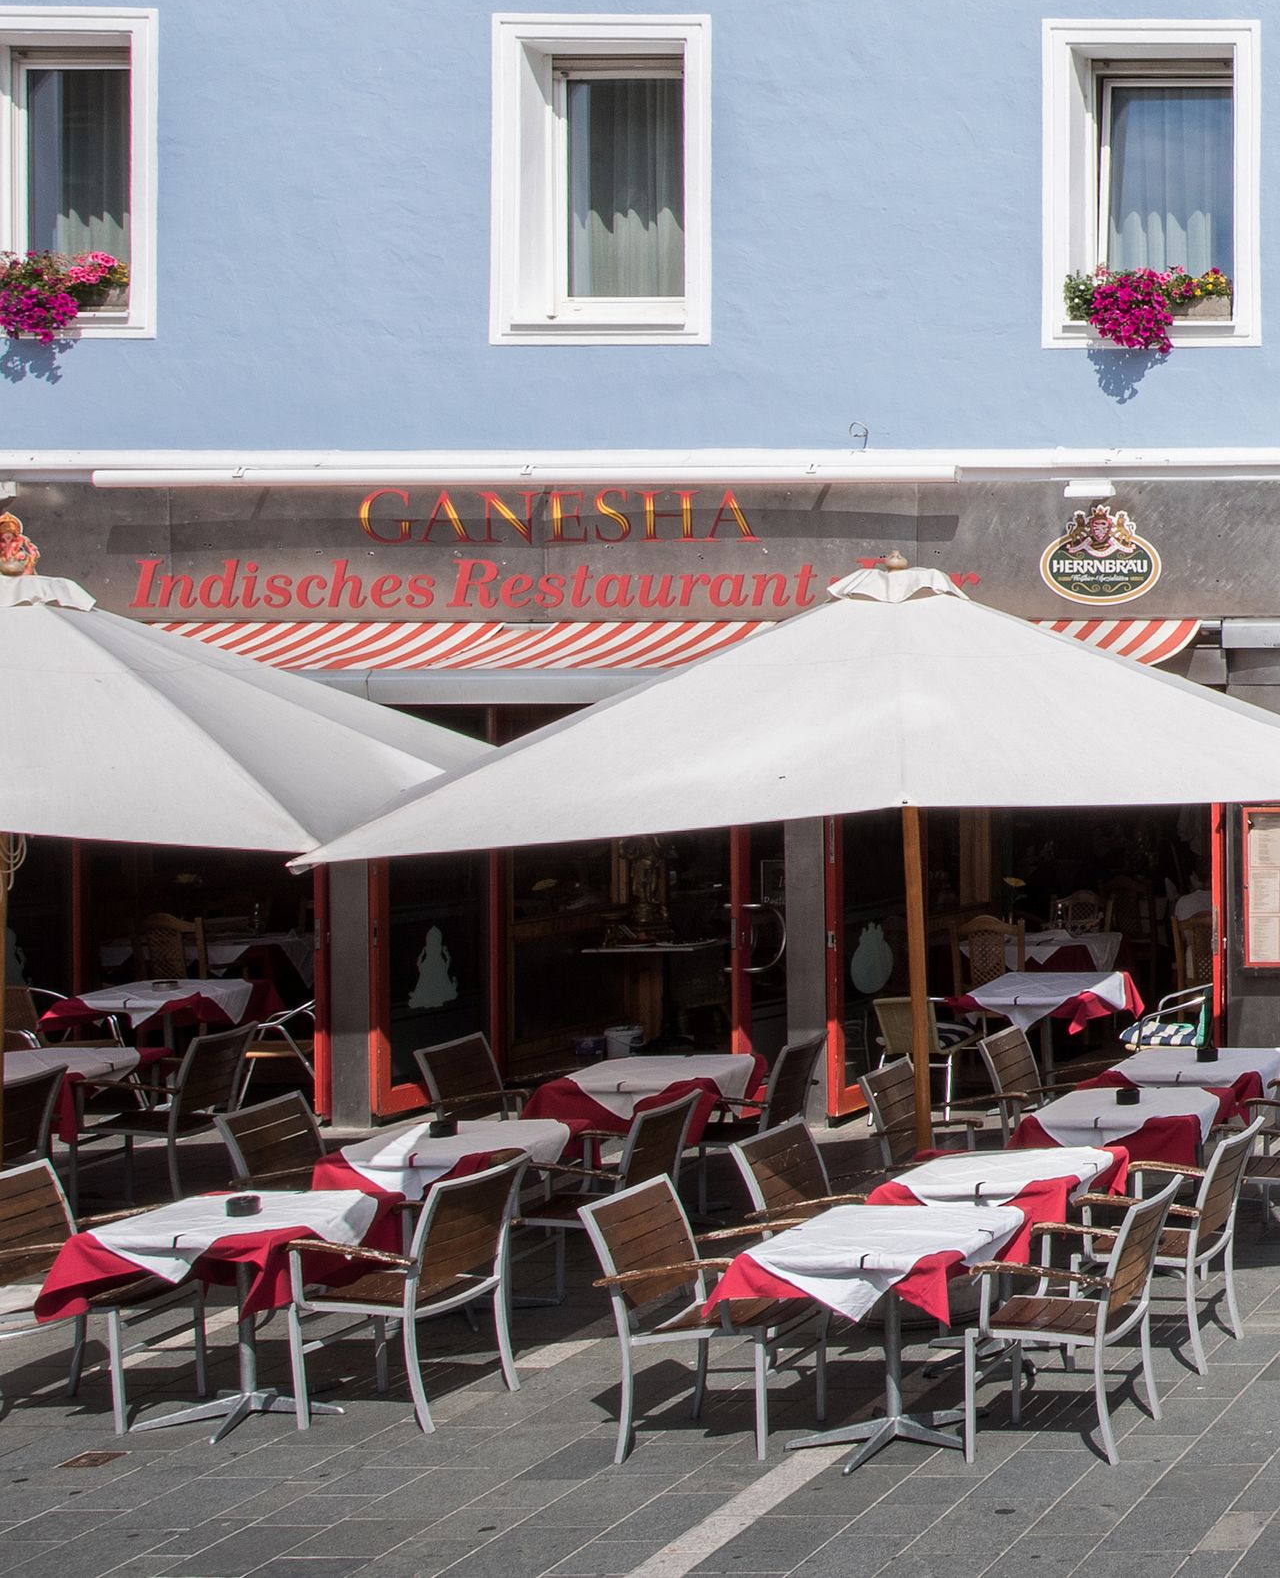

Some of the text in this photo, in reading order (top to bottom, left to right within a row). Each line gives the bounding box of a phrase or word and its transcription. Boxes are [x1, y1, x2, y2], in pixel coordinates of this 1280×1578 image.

[357, 488, 761, 545] GANESHA
[128, 558, 436, 610] Indisches
[445, 558, 818, 610] Restaurant
[1052, 558, 1150, 575] HERRNBRÄU
